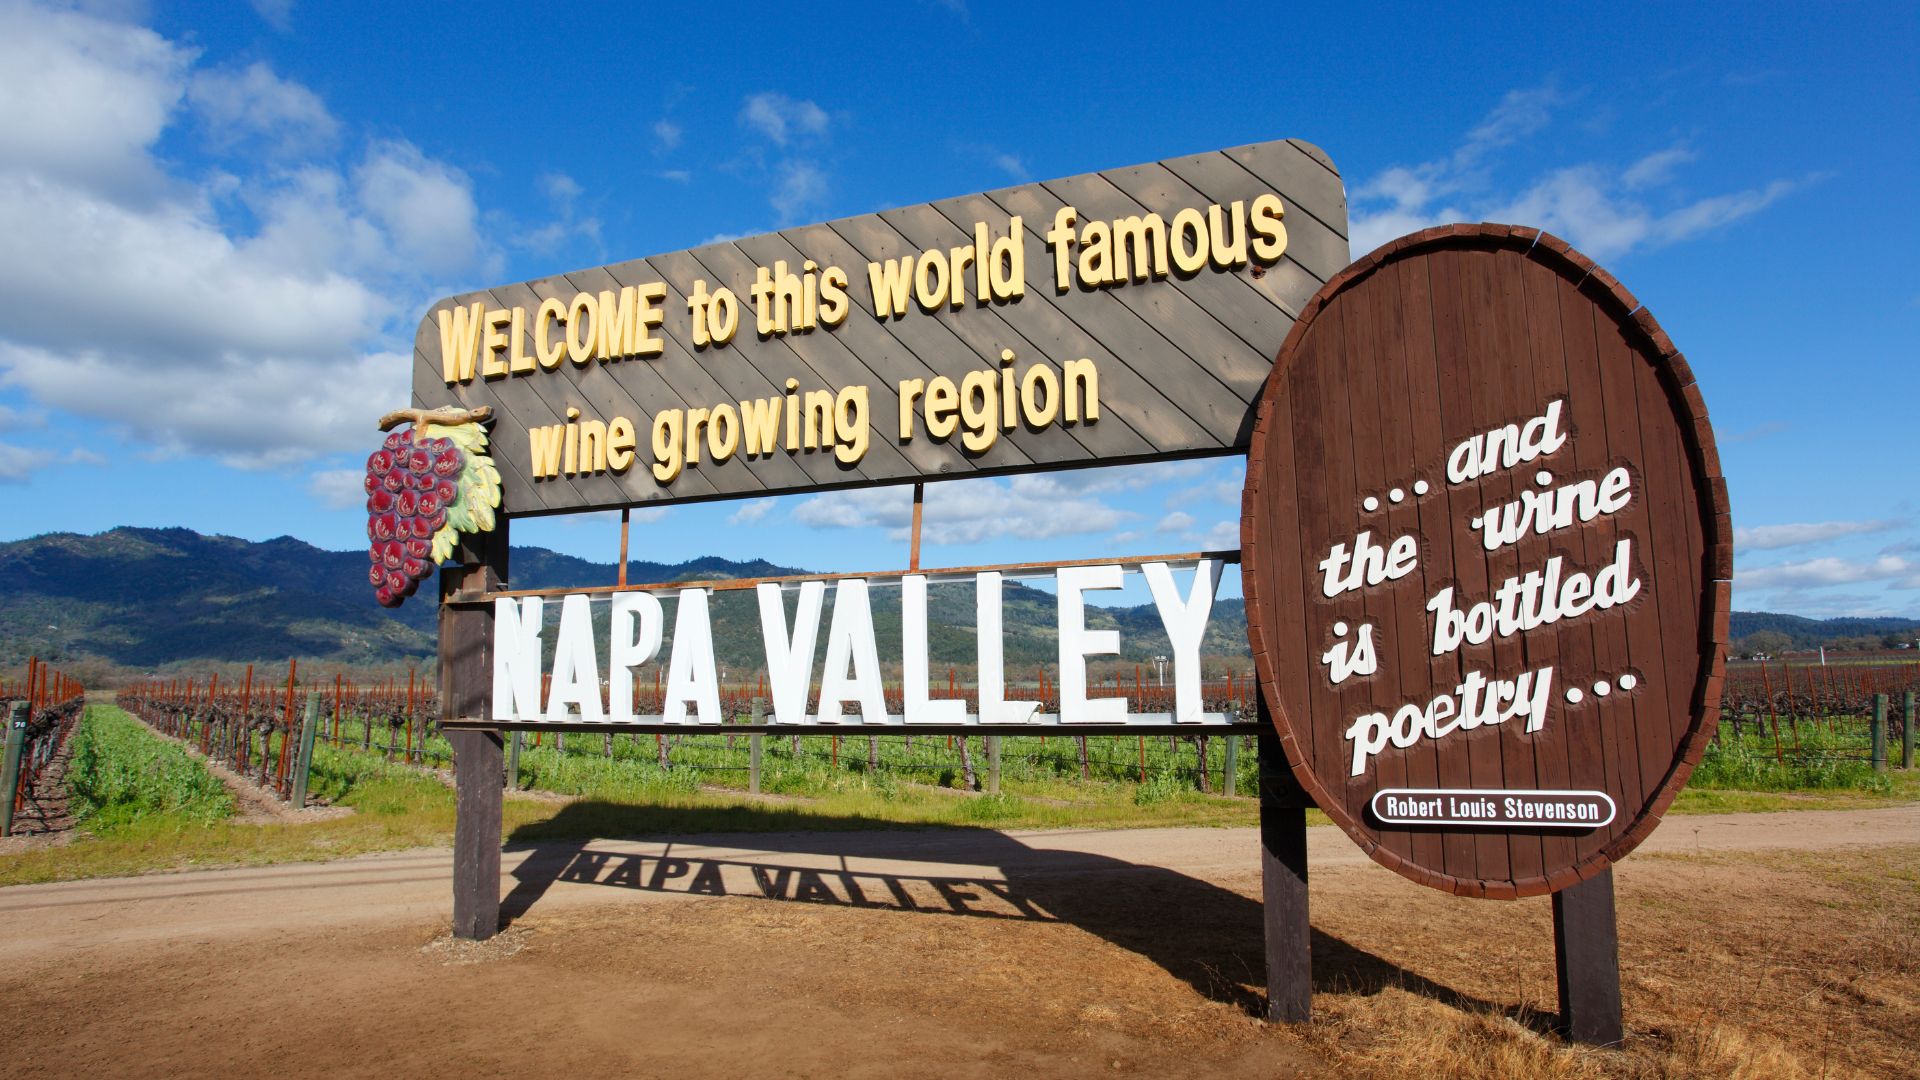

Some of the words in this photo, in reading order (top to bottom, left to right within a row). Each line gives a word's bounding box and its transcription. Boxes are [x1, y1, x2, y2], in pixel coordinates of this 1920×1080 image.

[437, 281, 667, 382] WELCOME
[686, 279, 739, 346] to
[750, 259, 849, 335] this
[867, 215, 1026, 317] world
[1046, 193, 1289, 290] famous
[528, 406, 636, 478] wine
[651, 377, 870, 482] growing
[899, 348, 1100, 452] region
[1319, 530, 1418, 598] the
[1471, 466, 1632, 551] wine
[492, 588, 723, 725] NAPA
[756, 558, 1225, 725] VALLEY
[1321, 621, 1379, 684] is
[1425, 538, 1641, 656] bottled
[1386, 796, 1444, 817] Robert
[1449, 797, 1498, 819] Louis
[1504, 797, 1599, 820] Stevenson
